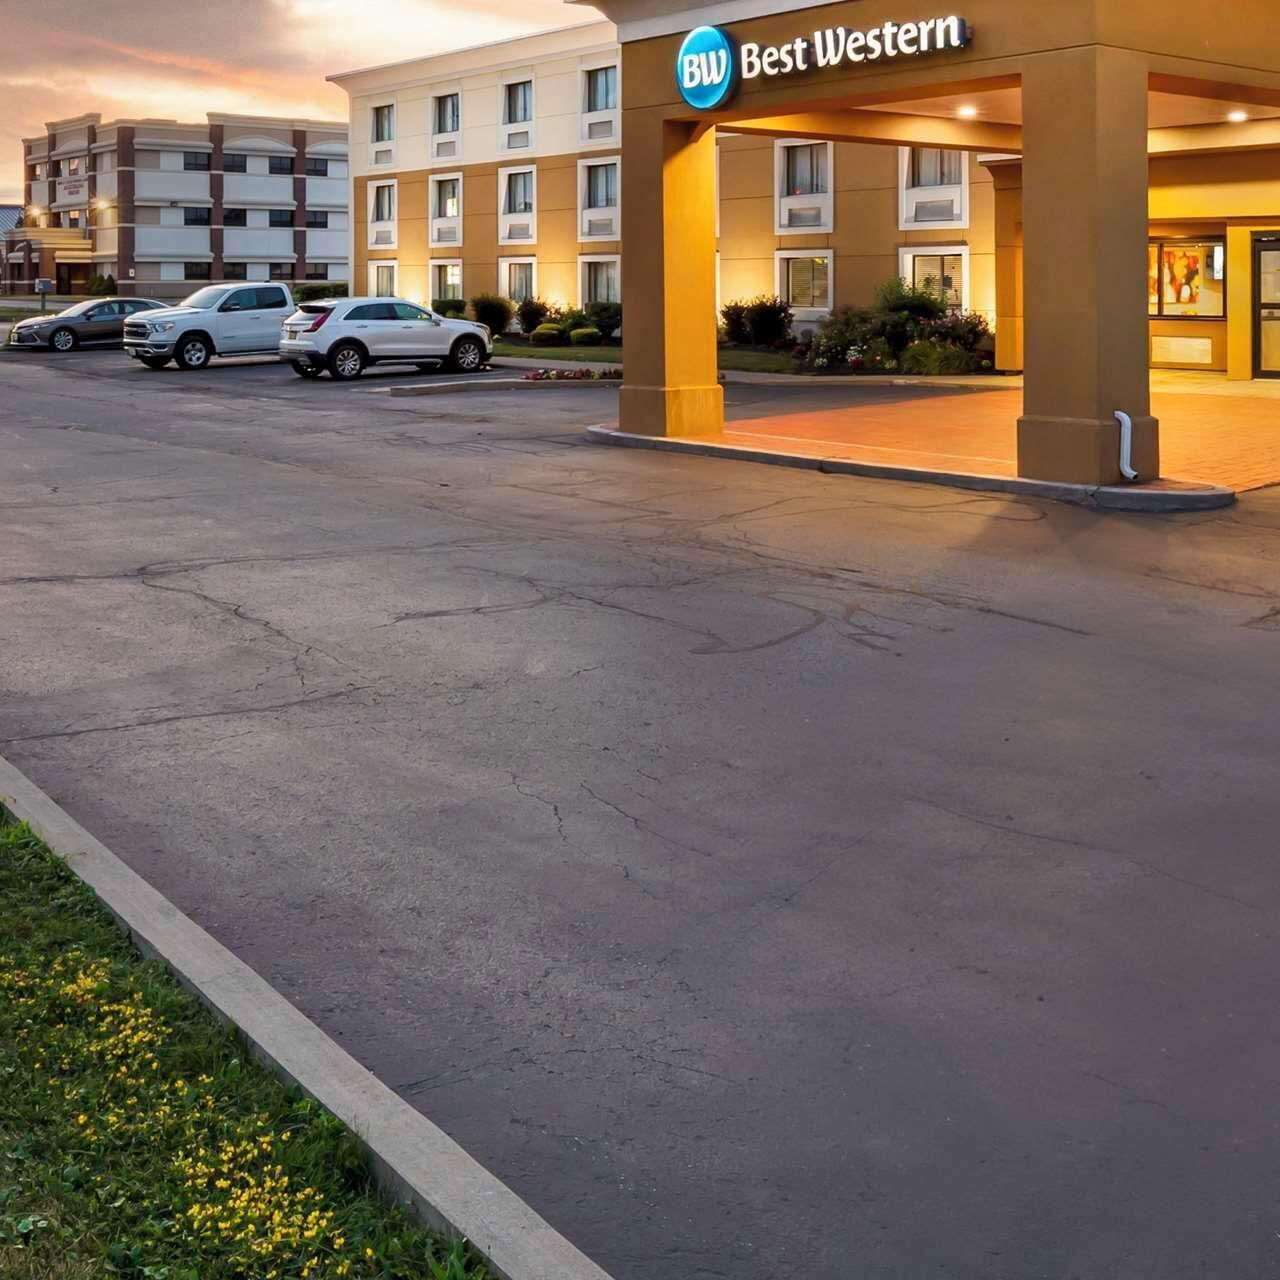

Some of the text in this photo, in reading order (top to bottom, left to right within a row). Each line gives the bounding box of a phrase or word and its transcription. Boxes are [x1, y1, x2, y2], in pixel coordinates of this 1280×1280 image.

[682, 48, 726, 89] BW
[741, 15, 961, 79] Best Western
